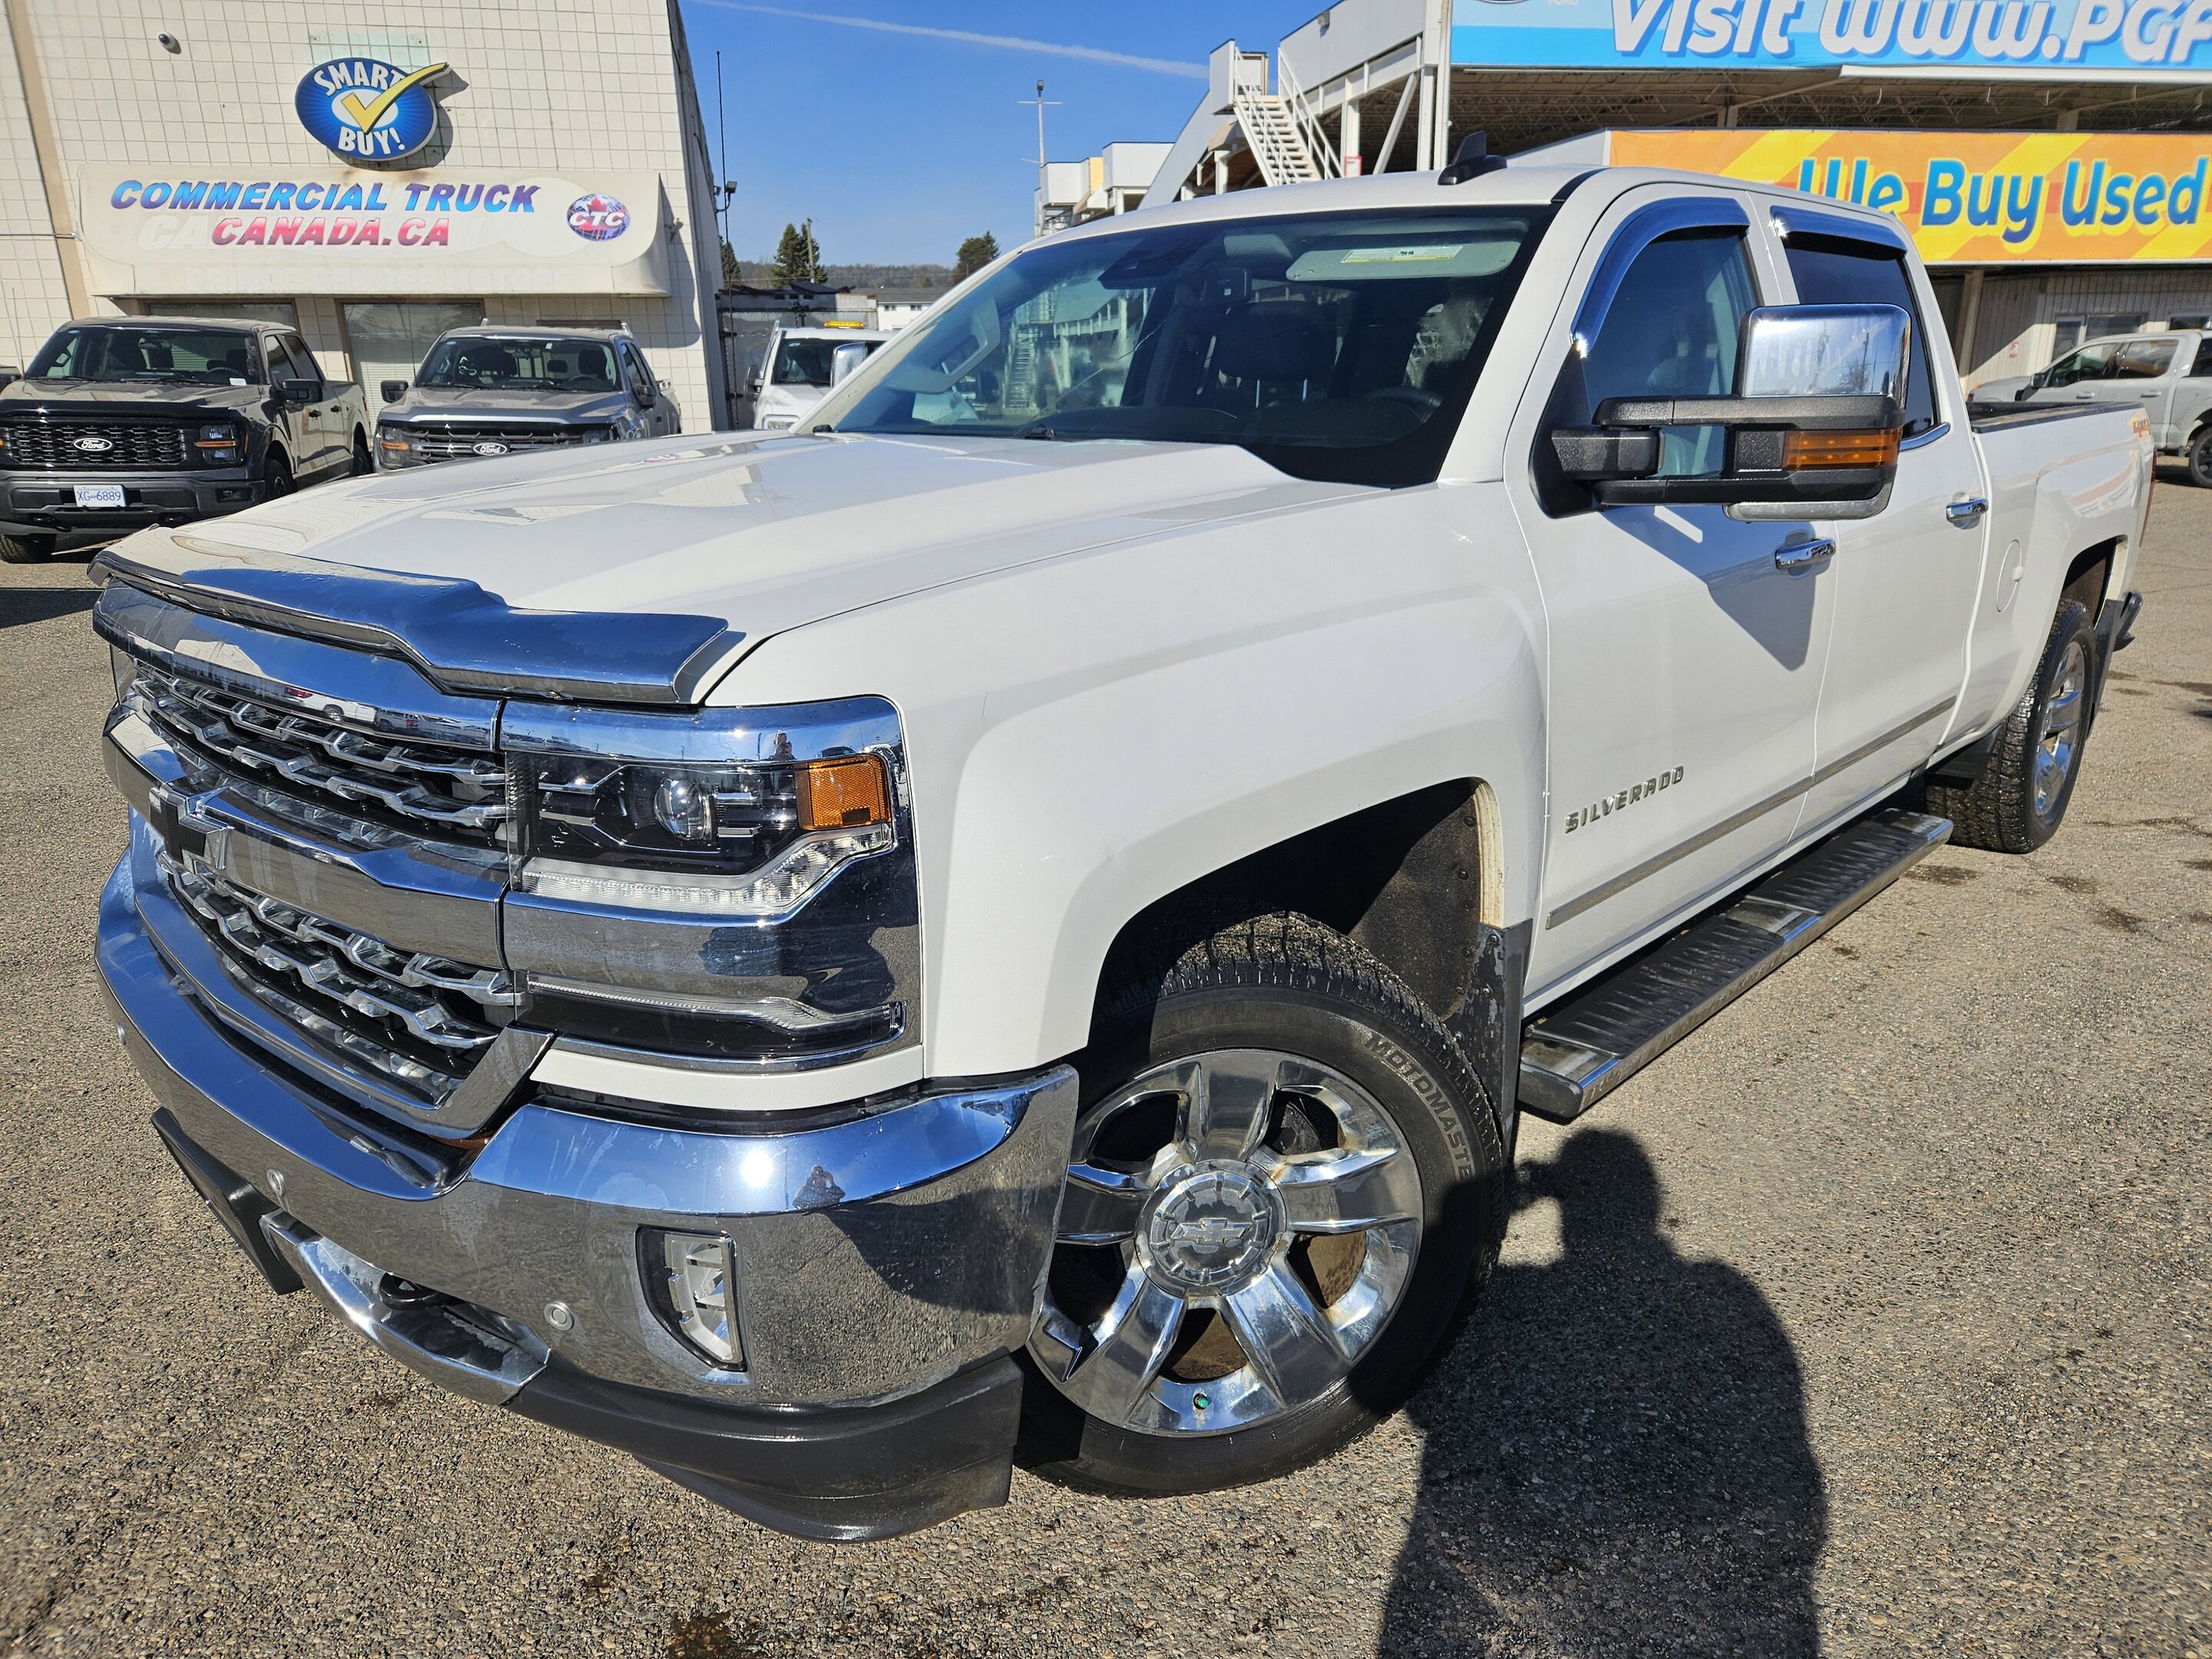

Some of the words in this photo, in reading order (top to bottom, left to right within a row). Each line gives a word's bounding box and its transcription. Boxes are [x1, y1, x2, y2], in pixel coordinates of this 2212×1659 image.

[1612, 0, 1800, 58] Visit
[313, 61, 406, 97] SMART
[337, 126, 406, 156] BUY!
[110, 180, 388, 211] COMMERCIAL
[404, 183, 541, 214] TRUCK
[1799, 158, 1903, 210] We
[1921, 159, 2045, 244] Buy
[2061, 157, 2210, 227] Used
[210, 216, 450, 247] CANADA.CA
[568, 211, 626, 228] CTC
[81, 439, 105, 449] Ford
[480, 445, 501, 453] Ford
[1564, 765, 1684, 834] SILVERADO
[1364, 1035, 1474, 1180] MOTOMASTE
